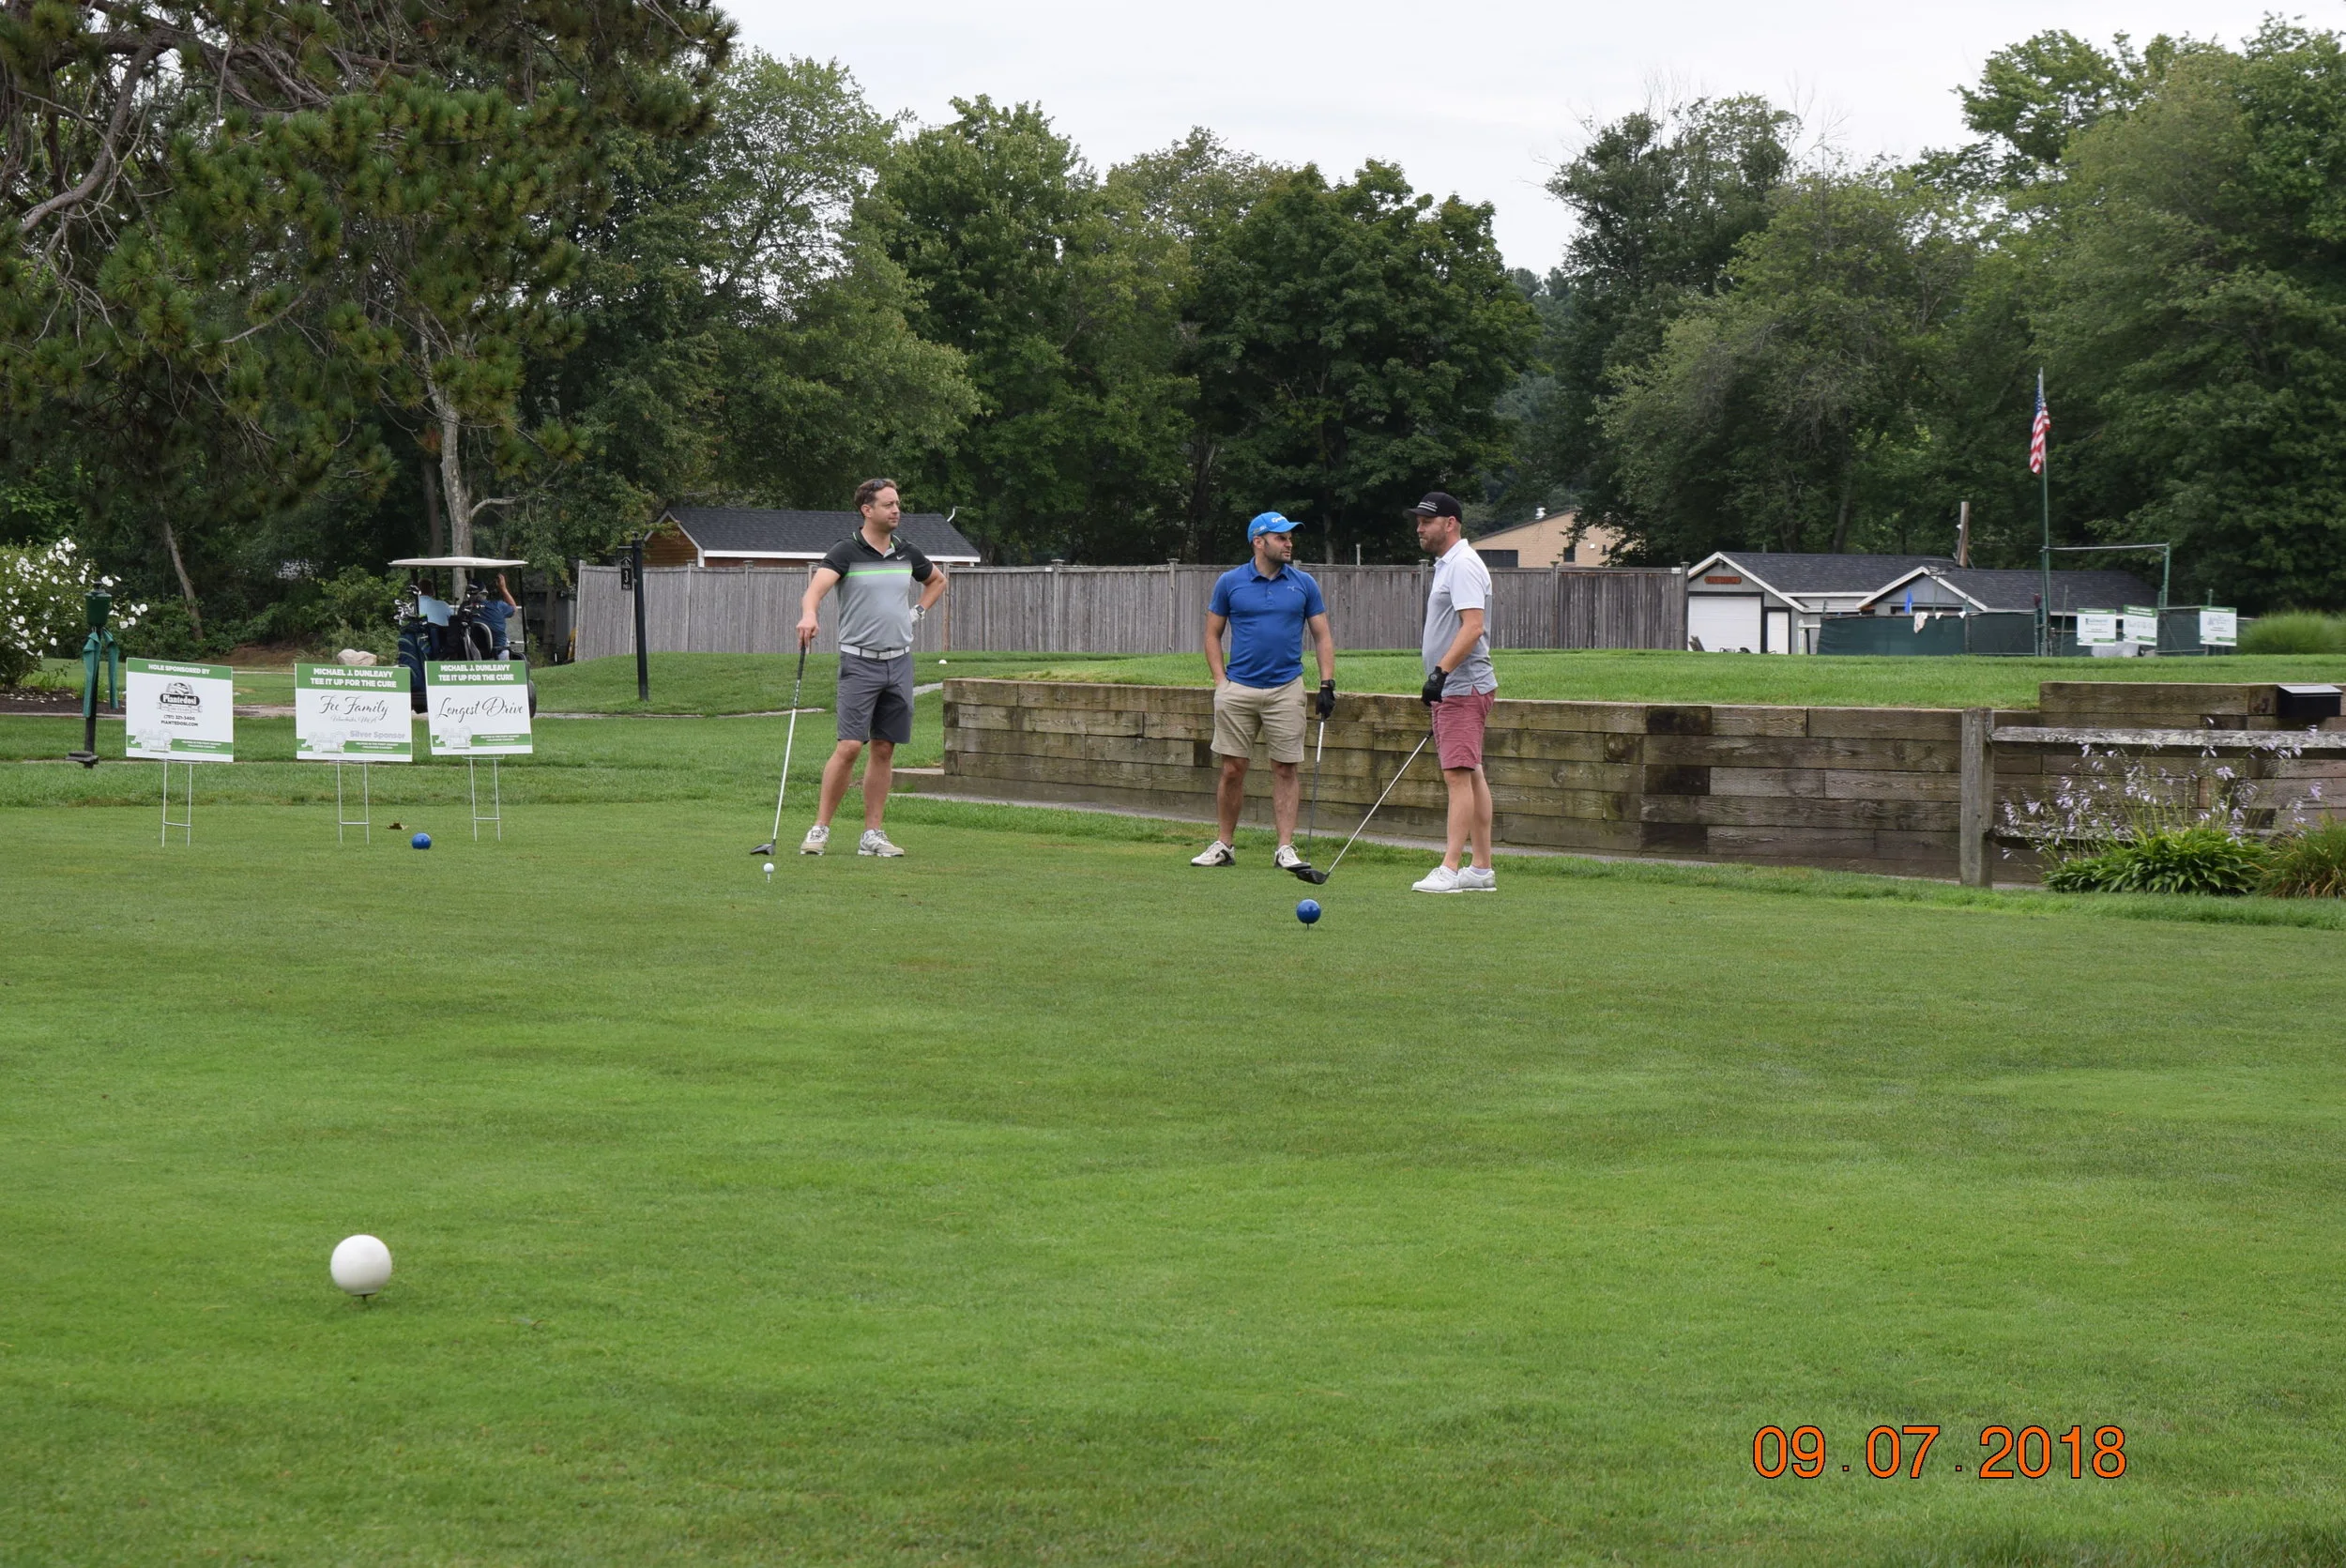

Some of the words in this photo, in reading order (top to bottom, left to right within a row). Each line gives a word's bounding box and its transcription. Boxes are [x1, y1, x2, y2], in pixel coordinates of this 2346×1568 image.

[165, 665, 201, 674] SPONSORED
[313, 667, 345, 676] MICHAEL
[354, 669, 393, 677] DUNLEAVY
[343, 695, 389, 721] Family
[437, 697, 480, 723] Longest
[481, 696, 524, 717] Drive
[373, 731, 406, 739] Sponsor
